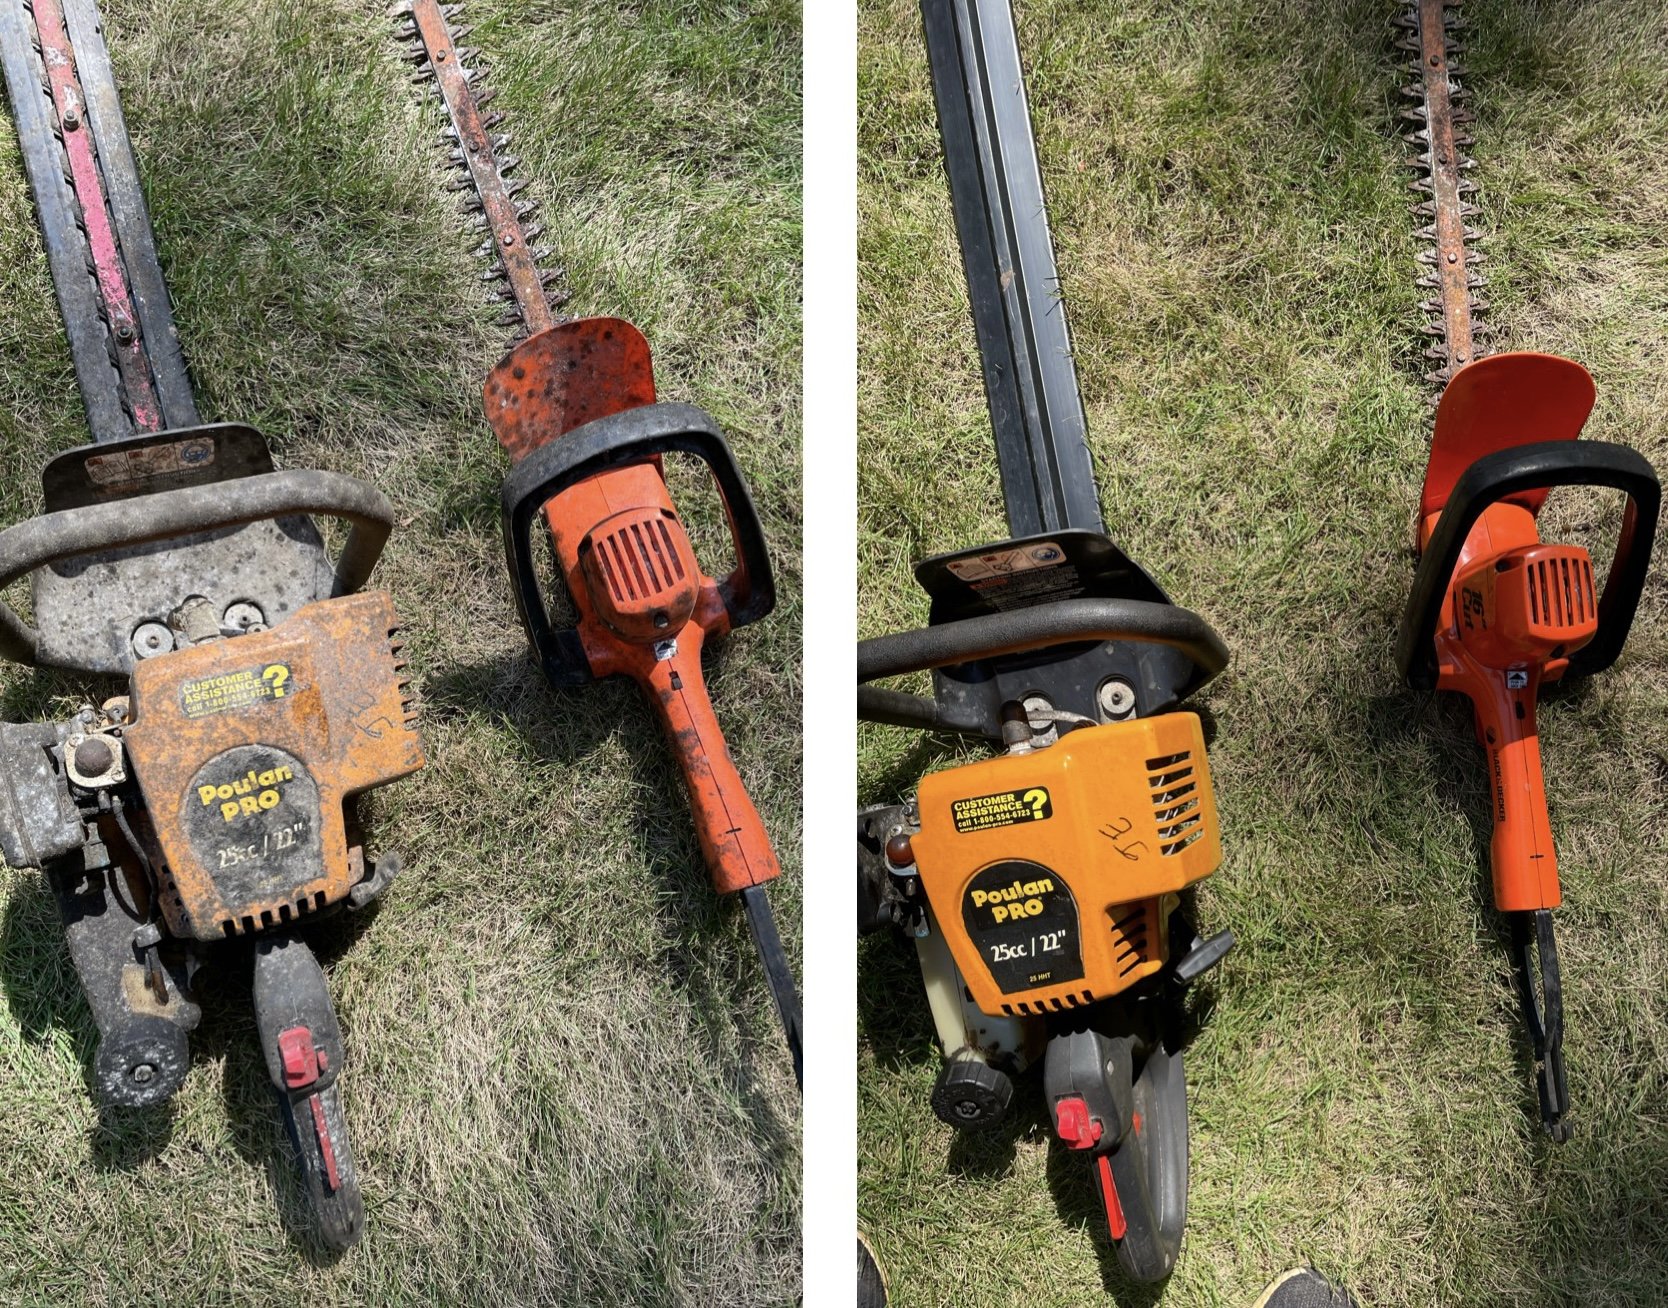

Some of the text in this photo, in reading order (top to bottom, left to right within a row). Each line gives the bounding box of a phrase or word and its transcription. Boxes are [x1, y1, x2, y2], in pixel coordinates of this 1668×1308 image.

[183, 671, 253, 695] CUSTOMER
[185, 679, 262, 704] ASSISTANCE
[263, 664, 289, 698] ?
[187, 703, 203, 713] call
[198, 765, 293, 806] Poulan
[220, 789, 280, 823] PRO
[954, 793, 1015, 811] CUSTOMER
[956, 801, 1023, 820] ASSISTANCE
[1023, 789, 1048, 820] ?
[958, 808, 1031, 828] call 1-800-554-6723
[971, 878, 1054, 908] Poulan
[991, 898, 1044, 924] PRO
[990, 943, 1028, 963] 25cc
[1039, 929, 1066, 952] 22"
[1029, 974, 1037, 982] 25
